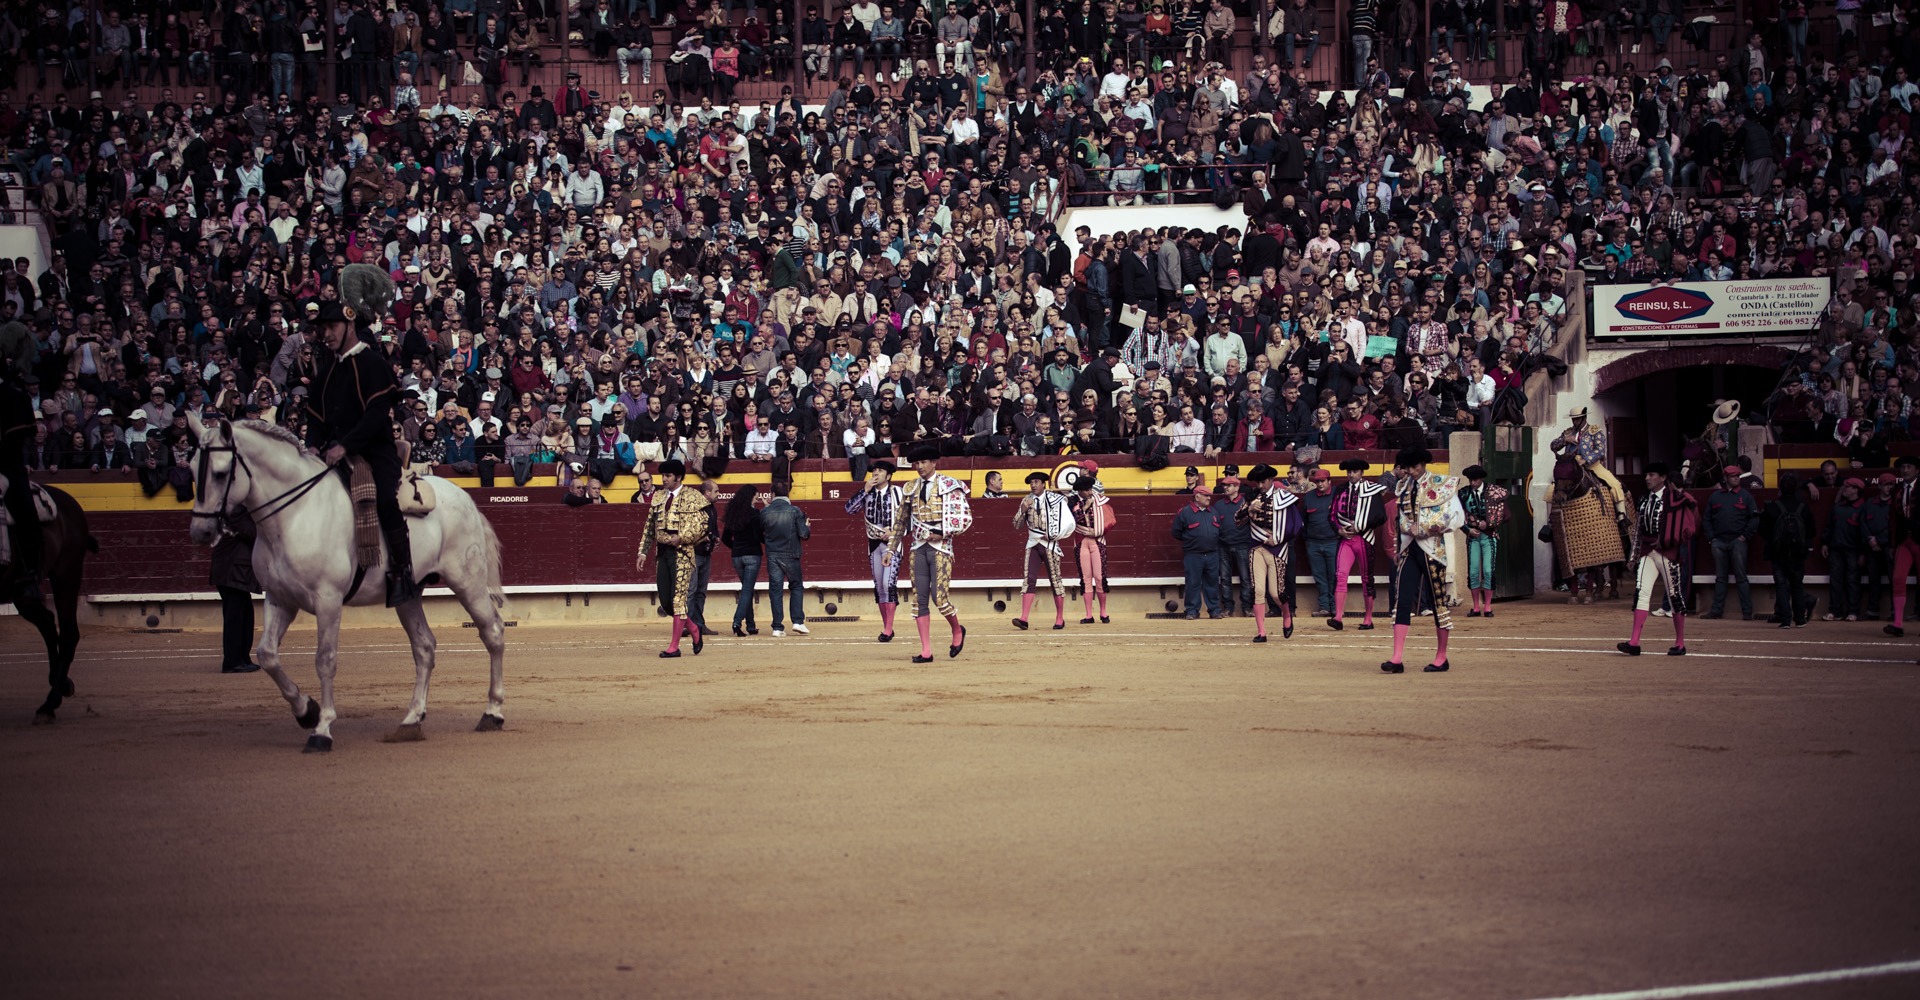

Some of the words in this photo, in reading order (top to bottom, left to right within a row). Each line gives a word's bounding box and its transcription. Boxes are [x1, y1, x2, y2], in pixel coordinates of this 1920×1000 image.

[1725, 284, 1772, 293] Construimos
[1775, 284, 1786, 292] tus
[1629, 302, 1670, 311] REINSU,
[1673, 301, 1692, 309] S.L.
[1740, 302, 1768, 310] ONDA
[1769, 301, 1814, 310] (Castellón)
[1741, 319, 1755, 327] 952
[1795, 317, 1809, 325] 952
[829, 490, 840, 498] 15
